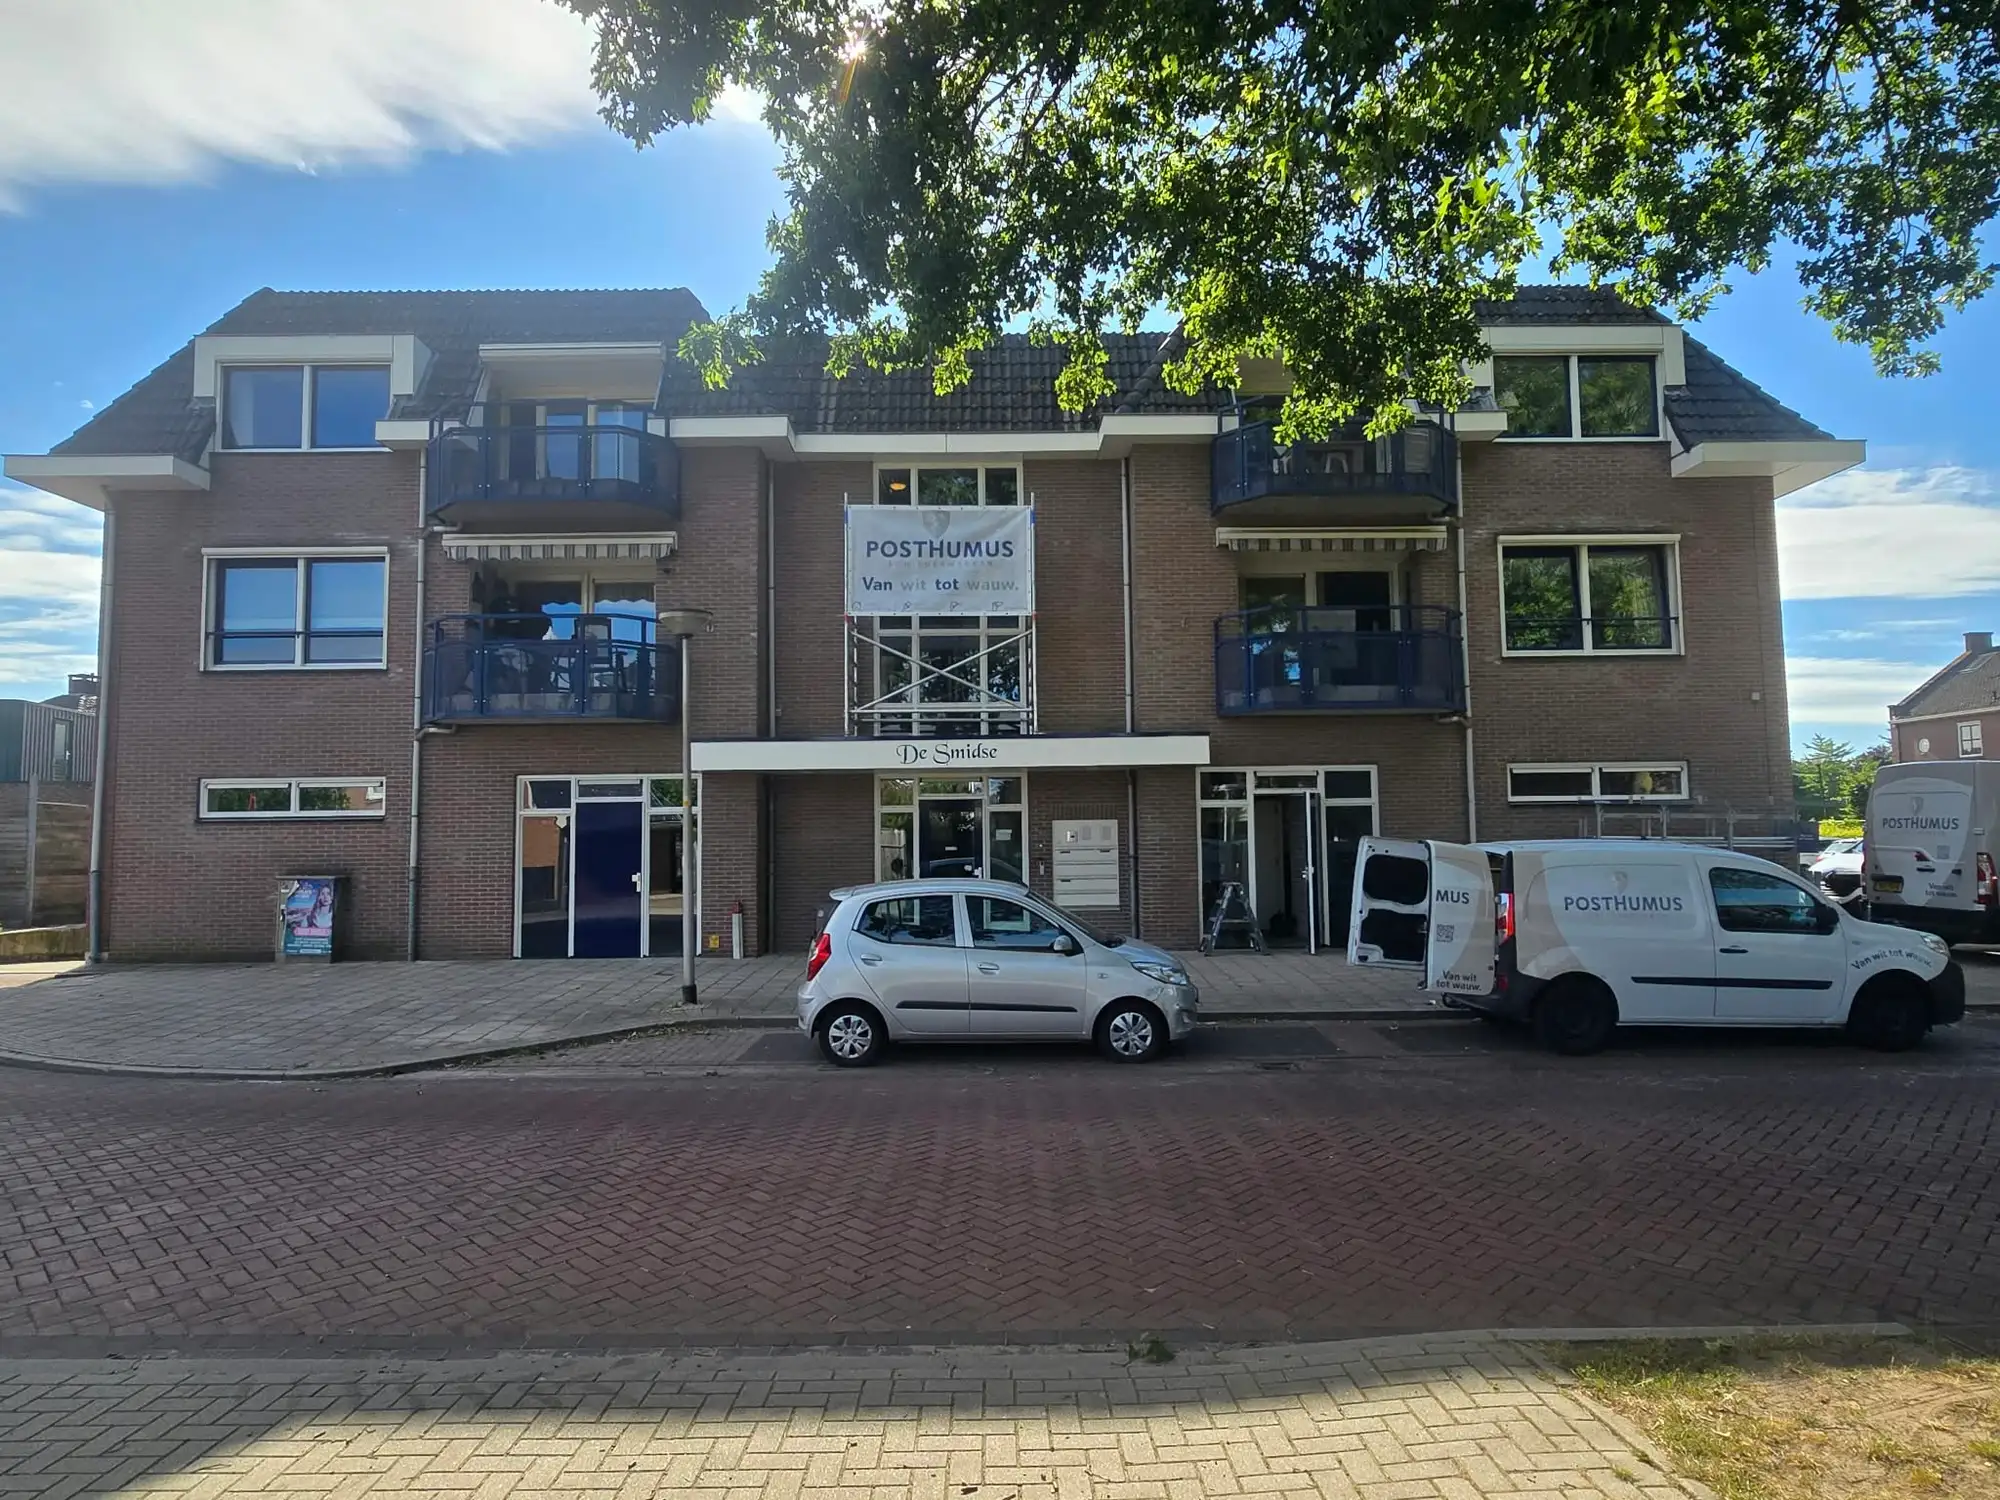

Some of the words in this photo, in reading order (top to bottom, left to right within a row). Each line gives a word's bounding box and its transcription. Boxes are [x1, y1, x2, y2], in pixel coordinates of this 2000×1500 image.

[866, 539, 1014, 558] POSTHUMUS
[862, 576, 893, 591] Van
[900, 579, 927, 592] wit
[935, 578, 960, 591] tot
[966, 581, 1019, 592] wauw.
[896, 744, 928, 765] De
[932, 742, 998, 765] Smidse
[1882, 816, 1960, 830] POSTHUMUS
[1435, 889, 1470, 905] MUS
[1564, 895, 1684, 911] POSTHUMUS
[1851, 956, 1873, 970] Van
[1436, 979, 1450, 989] tot
[1442, 970, 1461, 981] Van
[1462, 973, 1477, 982] wit
